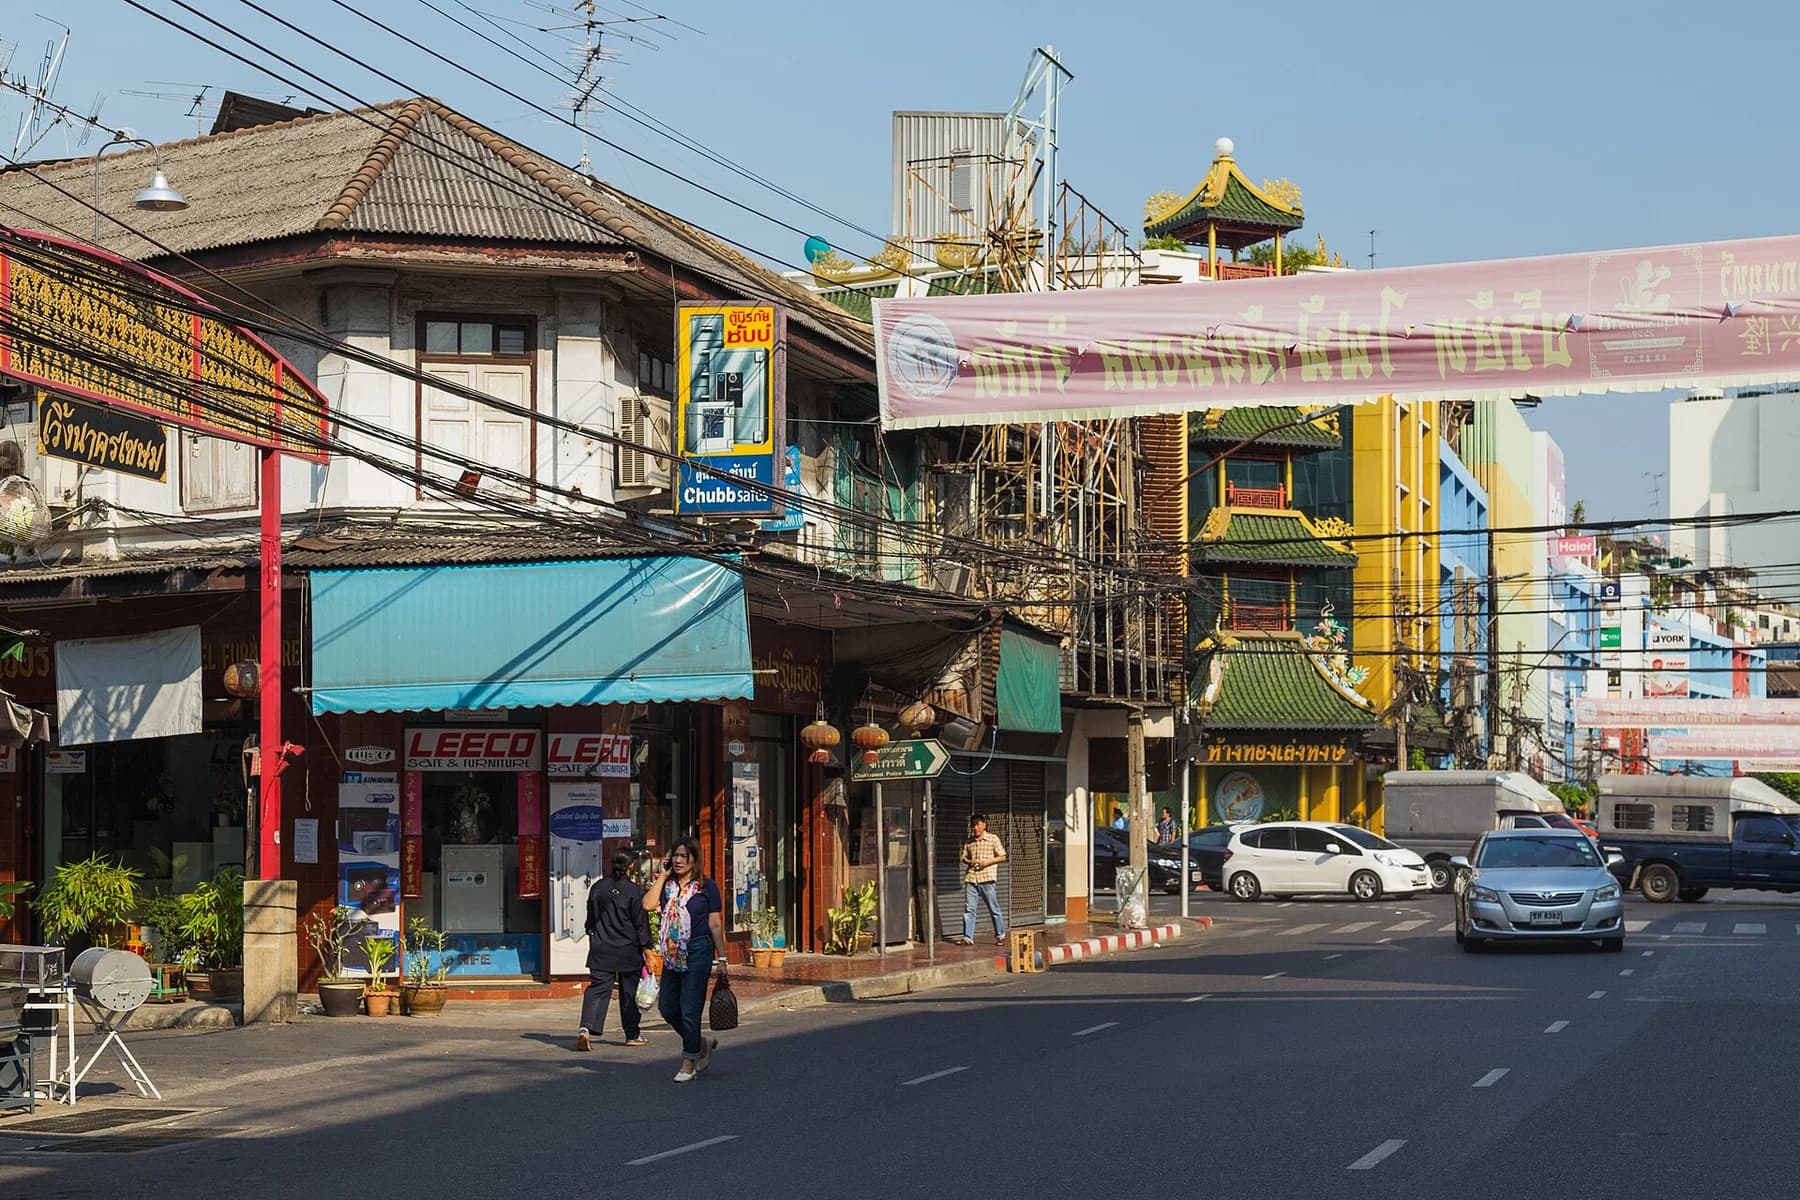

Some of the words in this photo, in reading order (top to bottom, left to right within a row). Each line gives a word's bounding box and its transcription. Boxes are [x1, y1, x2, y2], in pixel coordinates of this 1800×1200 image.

[729, 309, 770, 326] ตู้นิรภัย
[1559, 540, 1592, 553] Haier
[1661, 634, 1685, 643] YORK
[408, 732, 537, 758] LEECO
[463, 758, 530, 769] FURNITURE
